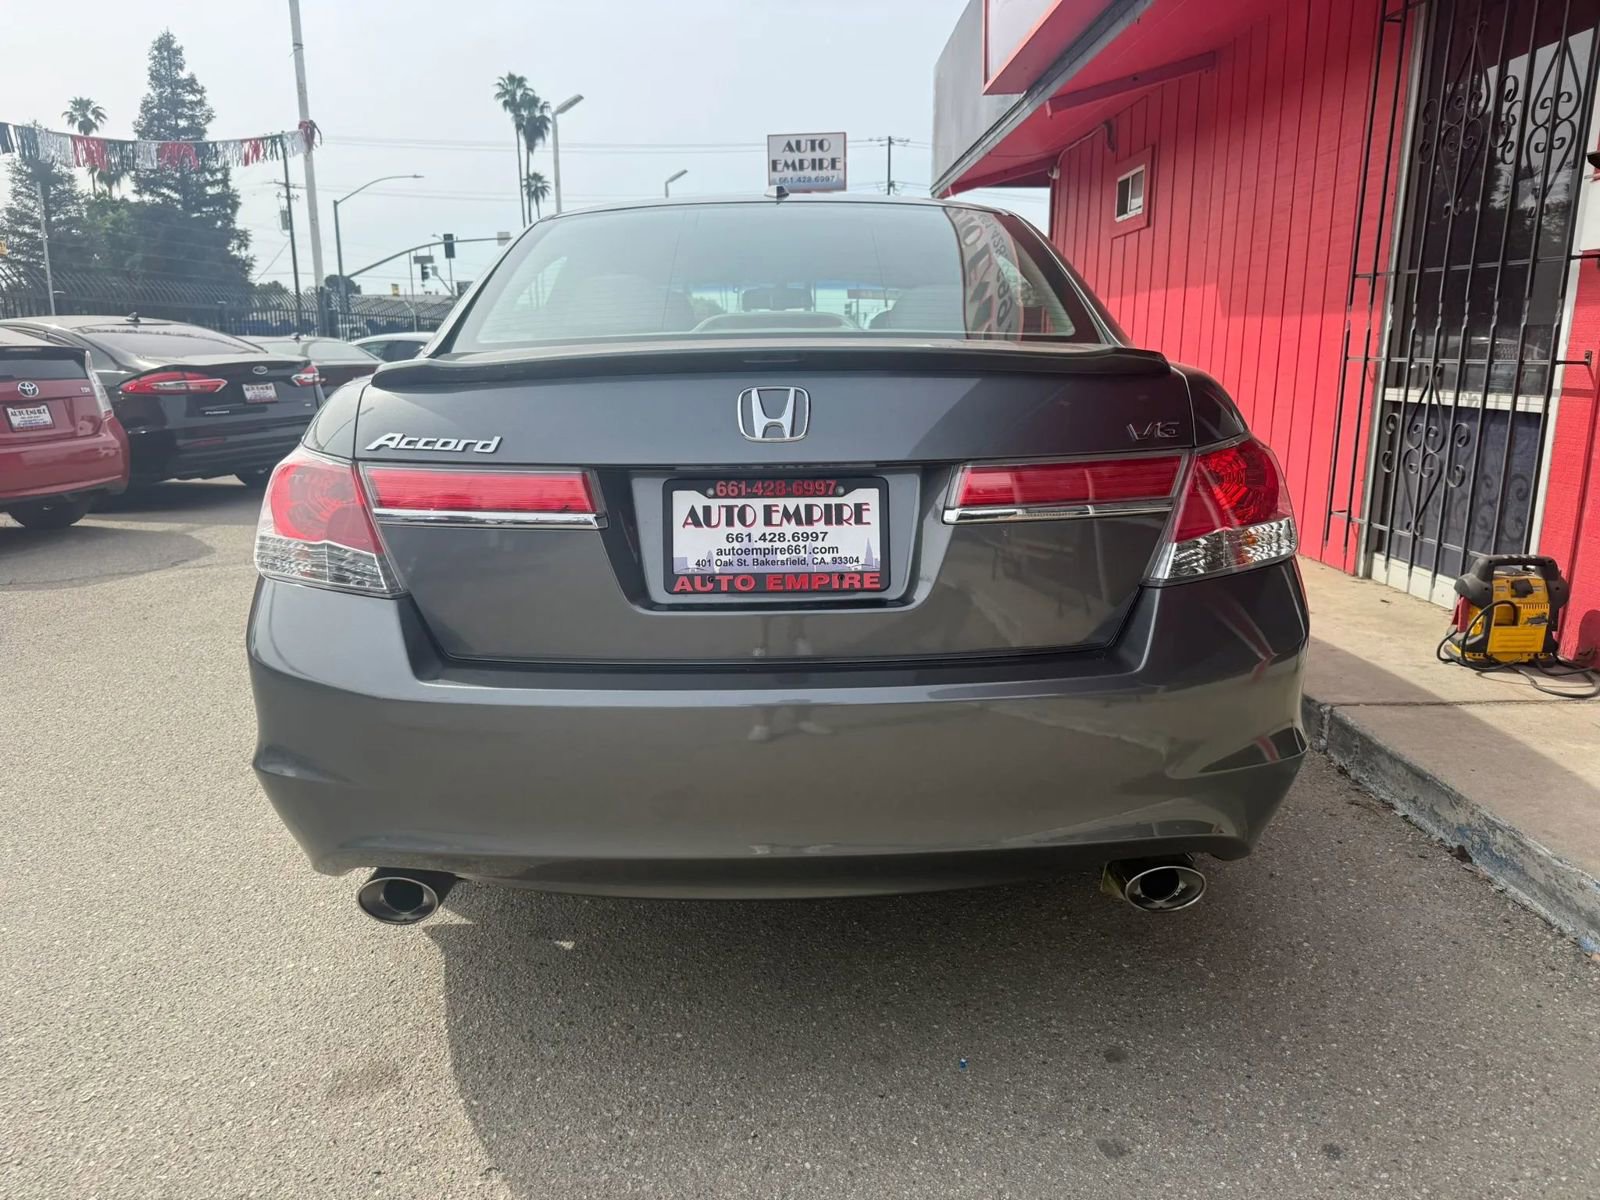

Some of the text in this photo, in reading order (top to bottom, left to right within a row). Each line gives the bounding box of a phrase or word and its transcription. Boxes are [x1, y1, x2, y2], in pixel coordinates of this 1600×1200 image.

[782, 138, 831, 153] AUTO
[771, 157, 842, 172] EMPIRE
[1126, 421, 1180, 442] V6
[365, 432, 502, 454] Accord
[716, 480, 837, 497] 661-428-6997
[682, 502, 872, 529] AUTO EMPIRE
[726, 531, 829, 544] 661.428.6997
[716, 544, 839, 558] autoempire661.com
[695, 555, 860, 568] 401 Oak St. Bakersfield, CA. 93304
[673, 572, 880, 593] AUTO EMPIRE
